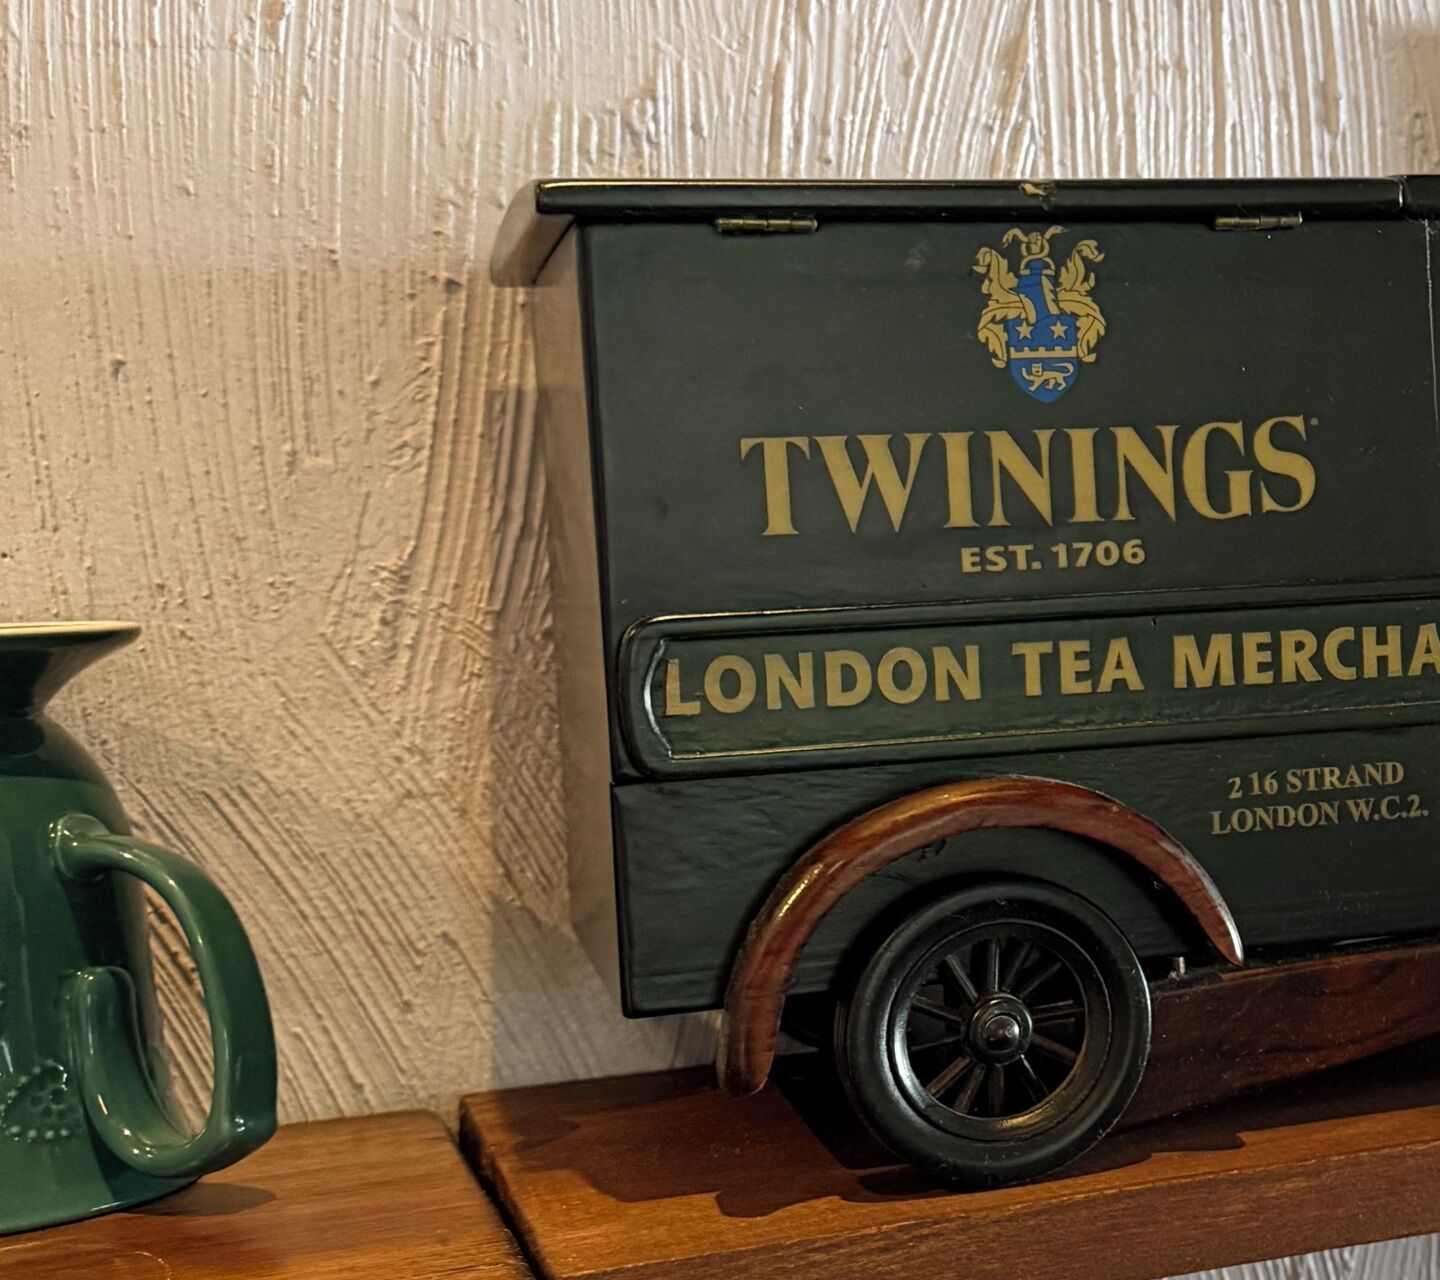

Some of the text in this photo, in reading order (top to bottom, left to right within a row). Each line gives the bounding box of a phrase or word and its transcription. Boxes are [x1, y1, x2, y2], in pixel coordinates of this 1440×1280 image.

[740, 414, 1317, 536] TWININGS
[961, 538, 1146, 573] EST. 1706
[664, 643, 982, 717] LONDON
[1012, 635, 1145, 696] TEA
[1286, 761, 1405, 794] STRAND
[1210, 793, 1429, 836] LONDON W.C.2.
